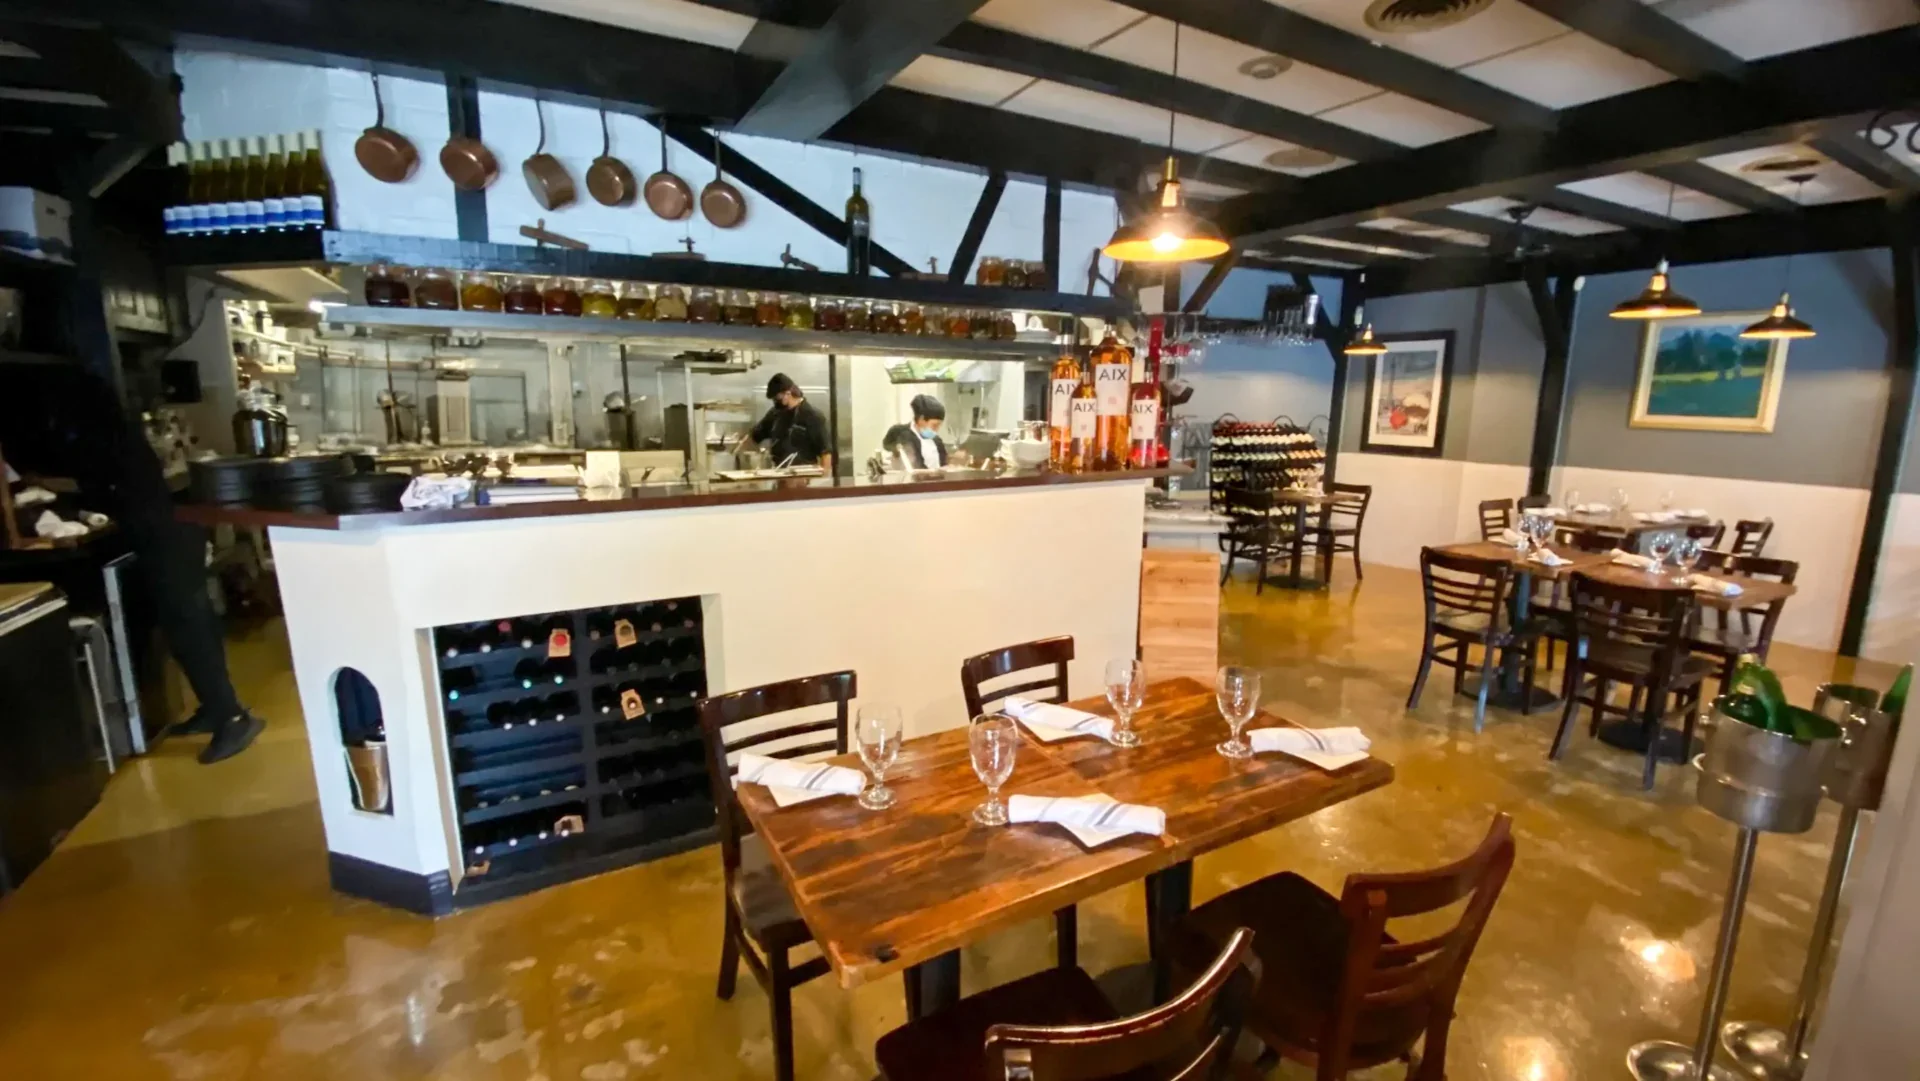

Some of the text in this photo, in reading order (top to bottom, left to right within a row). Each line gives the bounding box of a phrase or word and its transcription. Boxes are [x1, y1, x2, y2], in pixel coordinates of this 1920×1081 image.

[1098, 368, 1127, 381] AIX
[1073, 402, 1096, 413] AIX
[1133, 404, 1153, 414] AIX
